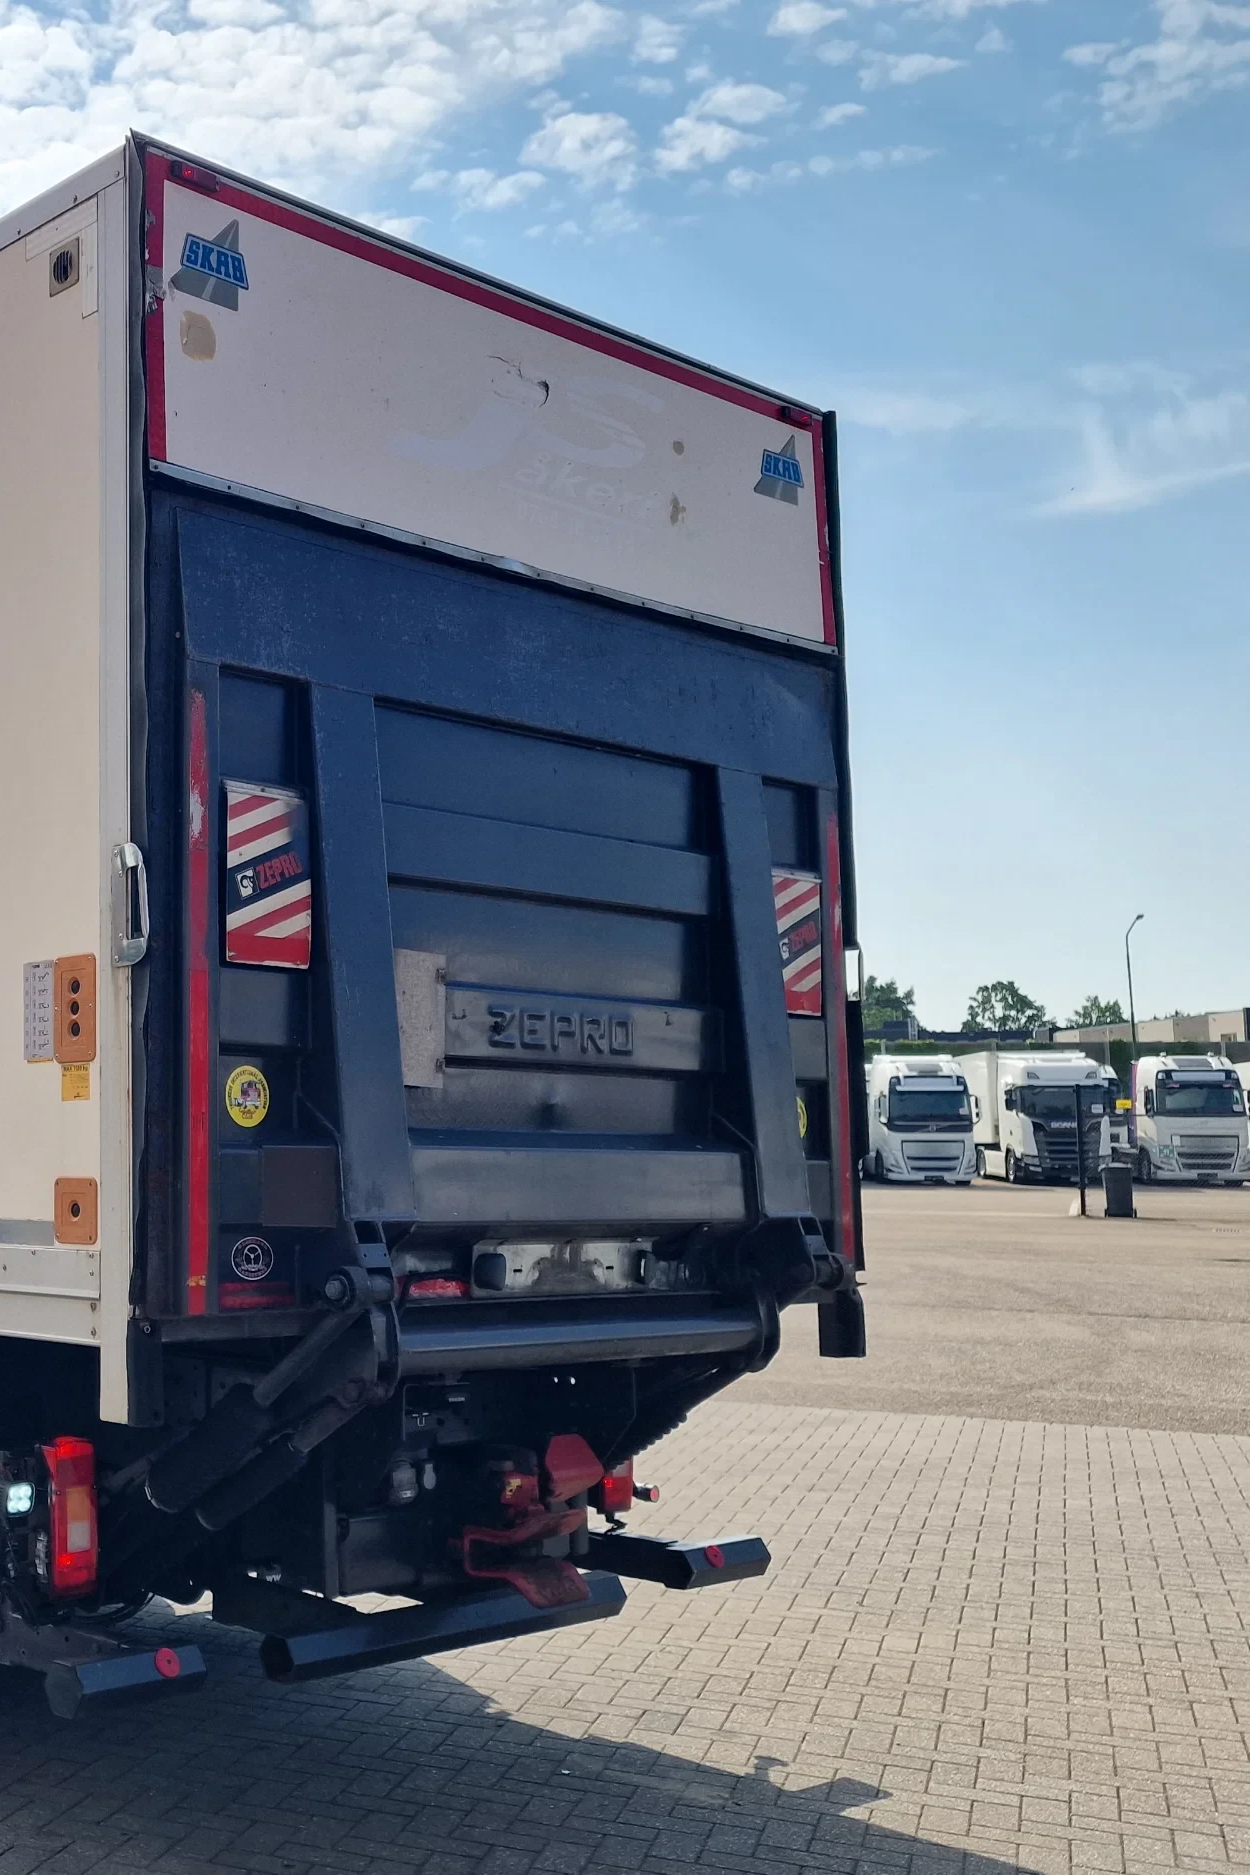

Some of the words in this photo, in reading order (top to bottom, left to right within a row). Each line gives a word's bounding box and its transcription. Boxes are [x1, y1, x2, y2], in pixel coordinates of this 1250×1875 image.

[185, 238, 246, 285] SKAB
[763, 452, 802, 484] SKAB
[255, 852, 303, 890] ZEPRO
[789, 921, 818, 953] ZEPRO
[487, 1003, 634, 1057] ZEPRO
